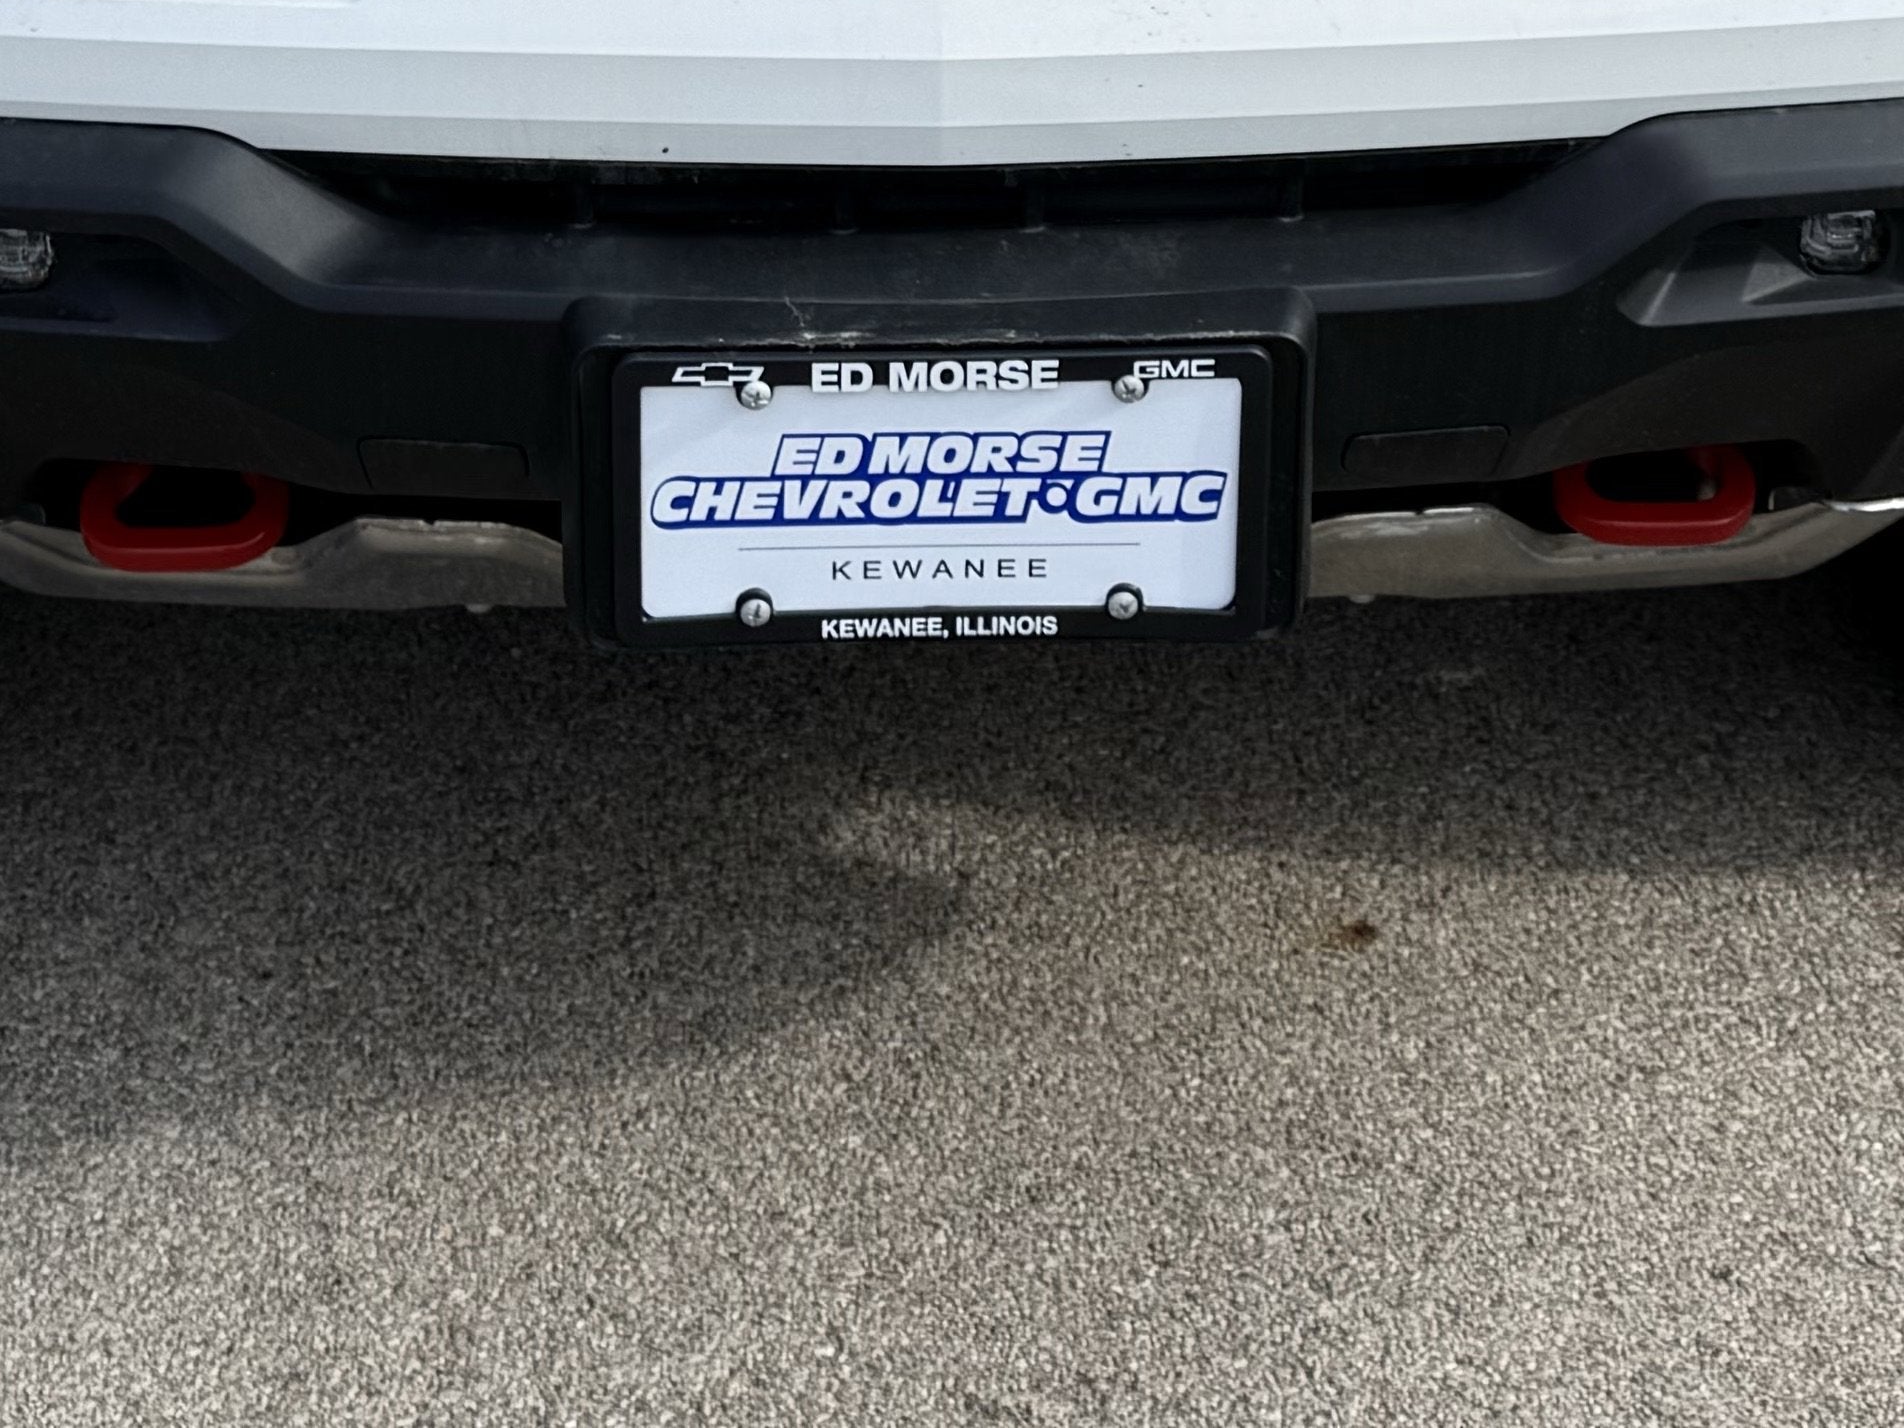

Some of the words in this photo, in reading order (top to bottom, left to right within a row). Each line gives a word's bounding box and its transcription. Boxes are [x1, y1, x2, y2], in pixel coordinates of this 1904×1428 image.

[811, 362, 873, 392] ED
[889, 359, 1060, 392] MORSE
[1133, 358, 1216, 379] GMC
[774, 435, 864, 476] ED
[867, 433, 1106, 474] MORSE
[831, 557, 1049, 581] KEWANEE
[821, 617, 949, 639] KEWANEE,
[956, 615, 1058, 636] ILLINOIS
